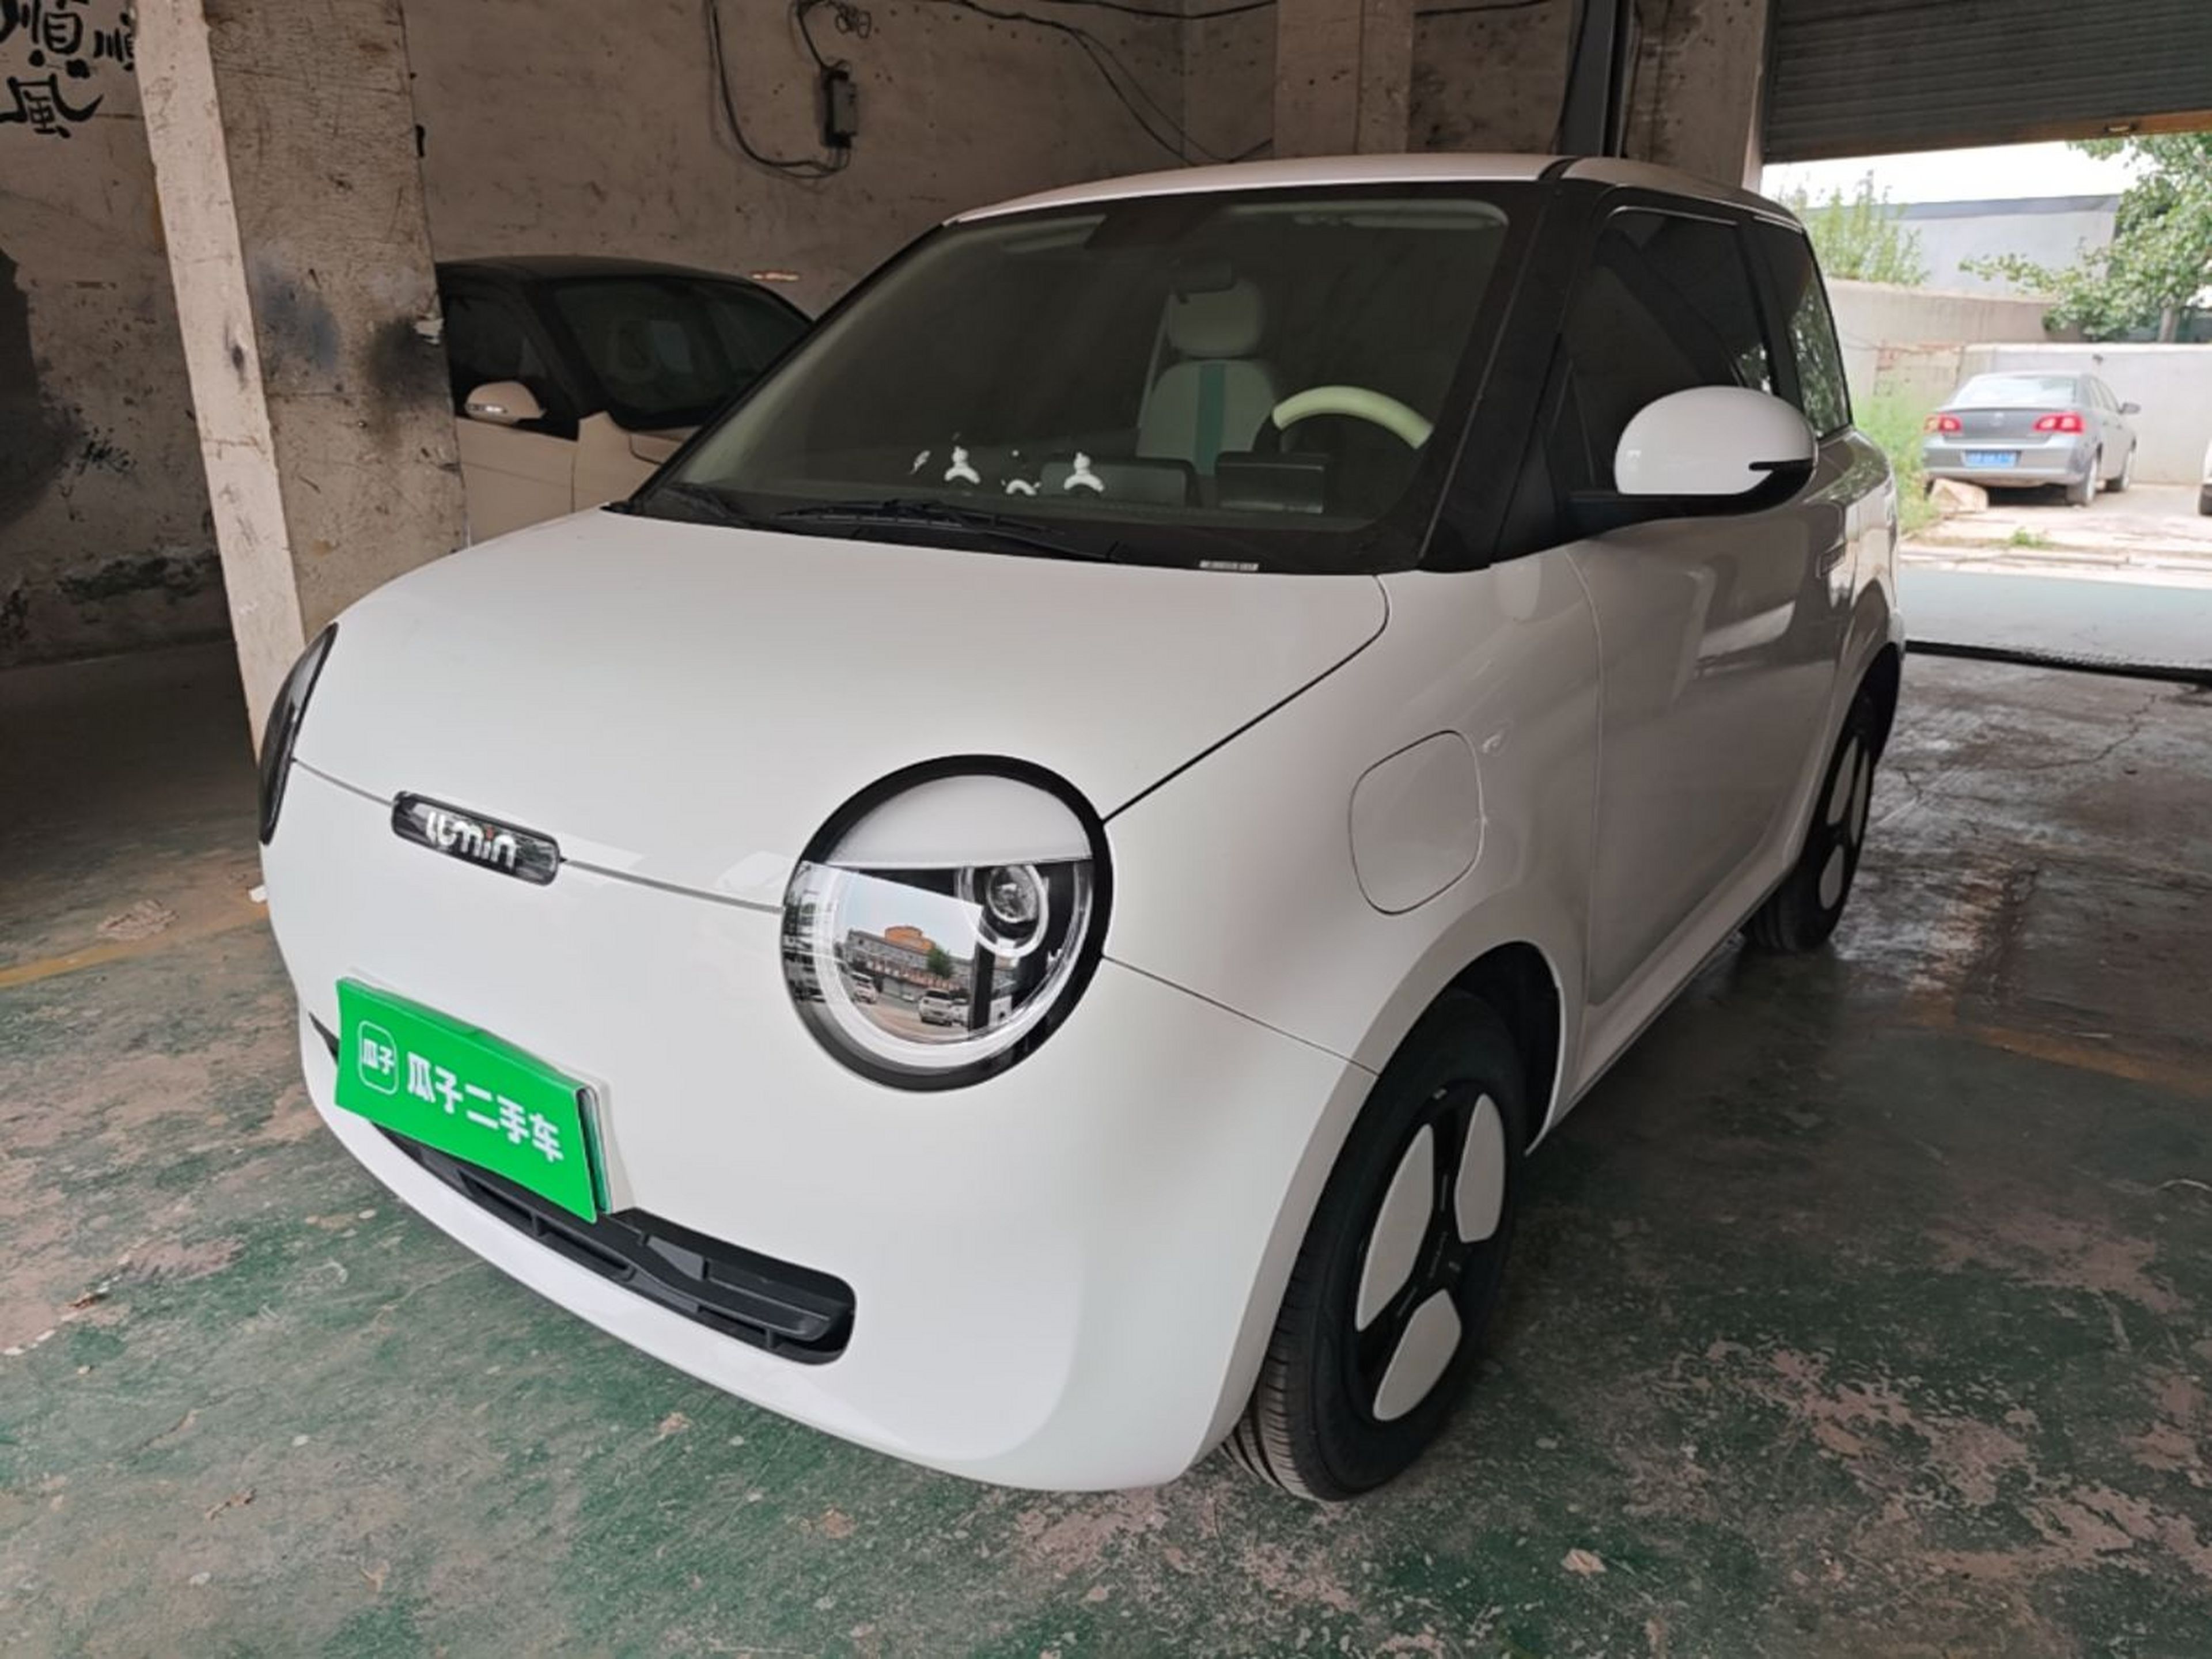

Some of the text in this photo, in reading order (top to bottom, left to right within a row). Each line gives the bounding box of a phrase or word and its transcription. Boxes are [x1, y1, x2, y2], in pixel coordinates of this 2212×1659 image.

[362, 1038, 395, 1075] 瓜子
[407, 1051, 564, 1162] 瓜子二手车
